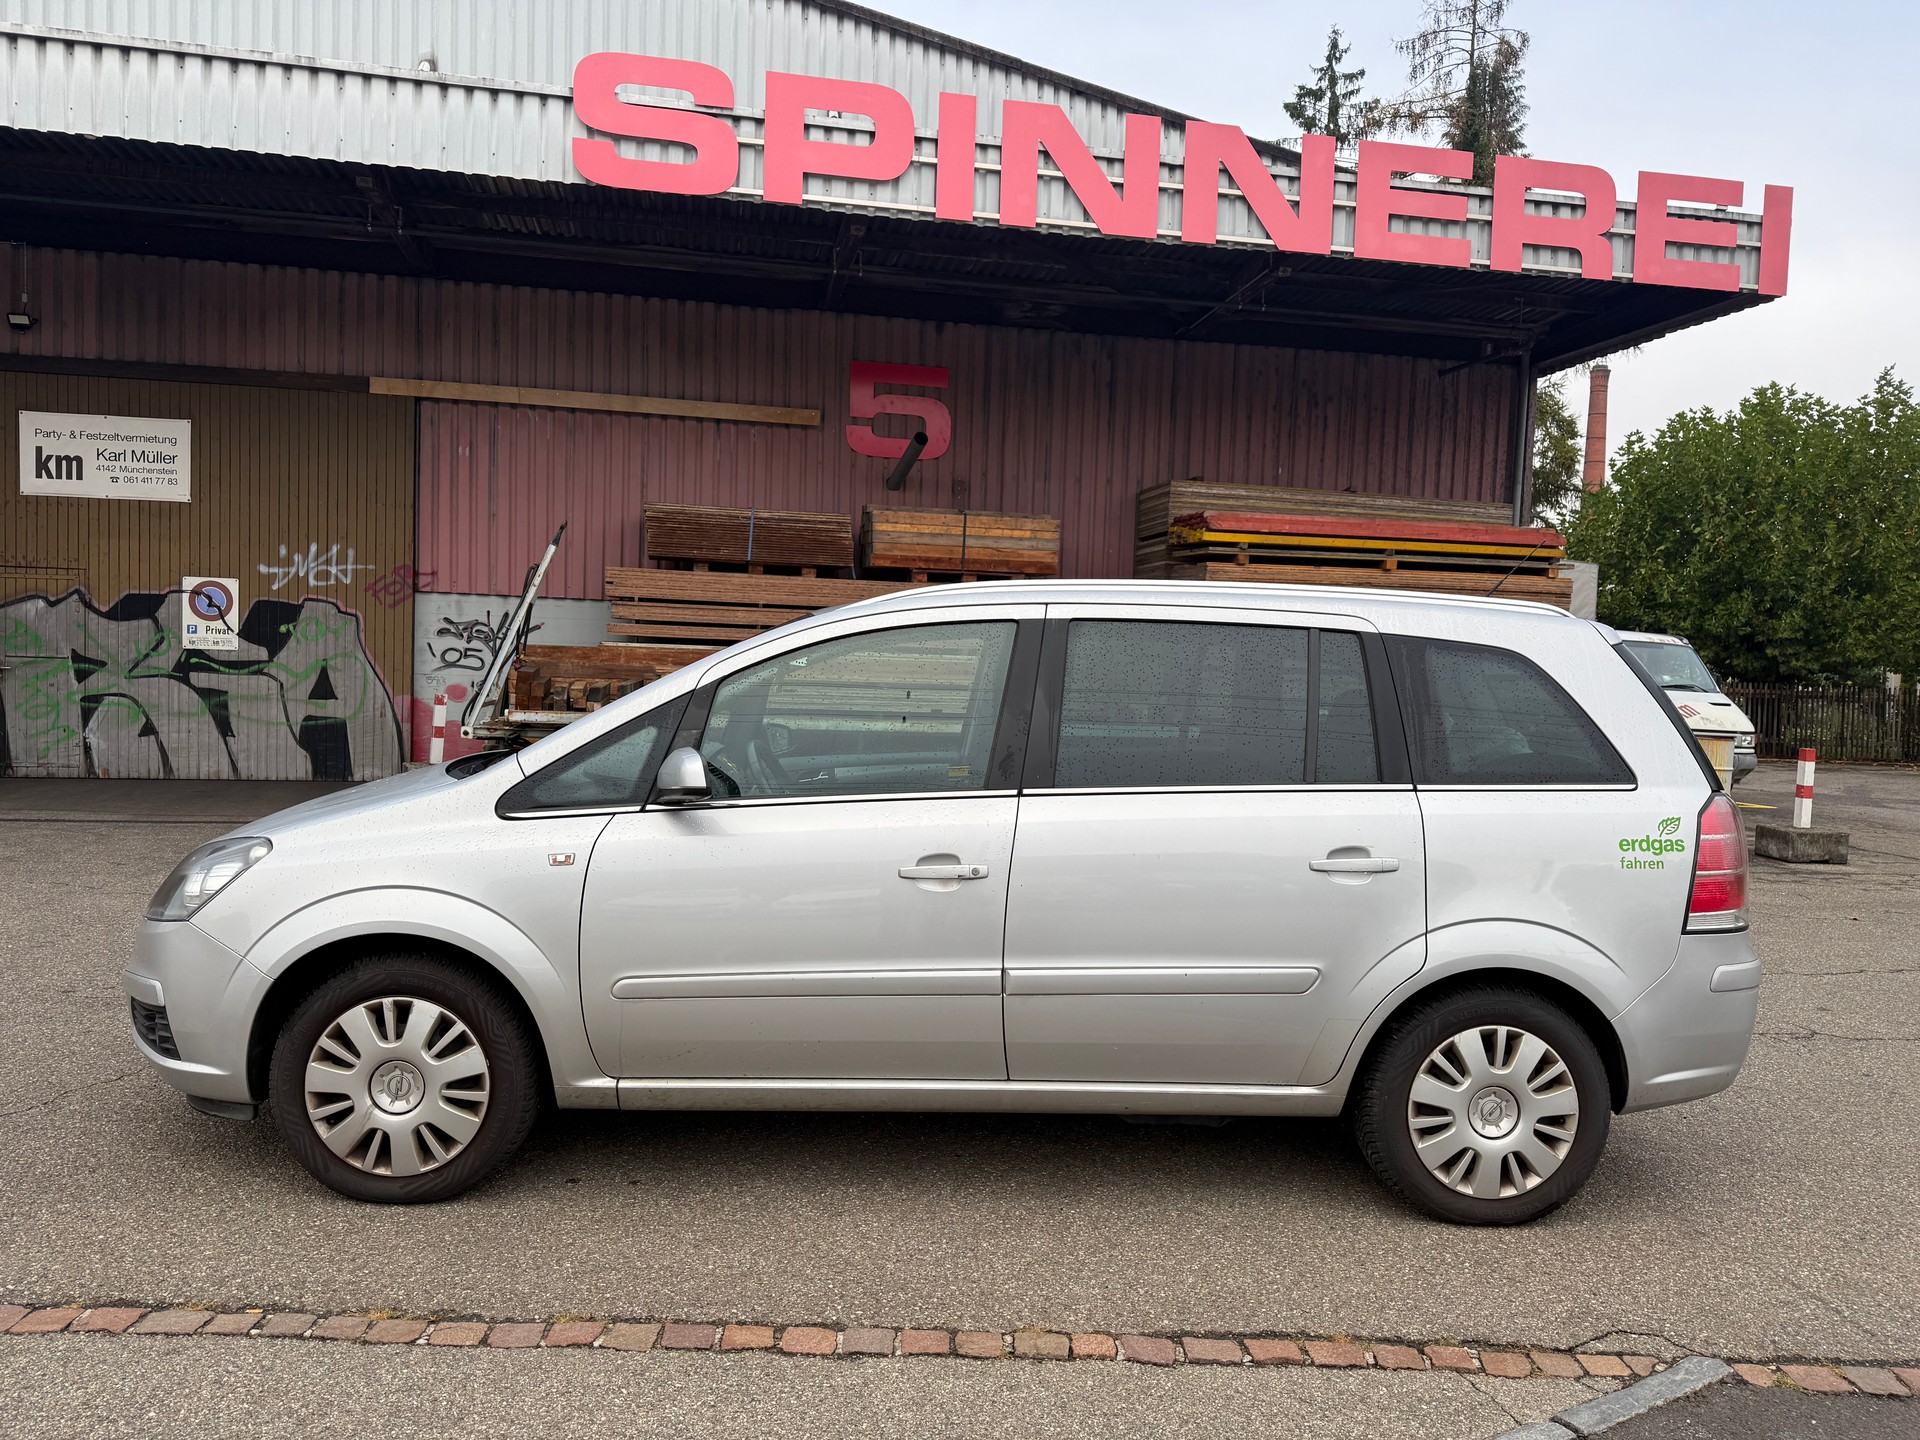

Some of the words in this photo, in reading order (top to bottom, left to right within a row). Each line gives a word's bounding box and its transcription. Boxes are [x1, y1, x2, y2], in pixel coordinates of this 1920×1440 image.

[572, 52, 1793, 296] SPINNEREI
[845, 360, 952, 461] 5
[34, 428, 67, 441] Party-
[69, 430, 77, 440] &
[79, 430, 178, 447] Festzeltvermietung
[35, 445, 84, 481] km
[96, 447, 127, 462] Karl
[131, 449, 178, 465] Müller
[95, 464, 117, 473] 4142
[119, 465, 178, 476] Münchenstein
[123, 475, 139, 484] 061
[140, 476, 153, 485] 411
[155, 477, 166, 485] 77
[167, 477, 178, 486] 83
[205, 625, 231, 636] Privat
[1618, 834, 1686, 856] erdgas
[1620, 857, 1665, 870] fahren
